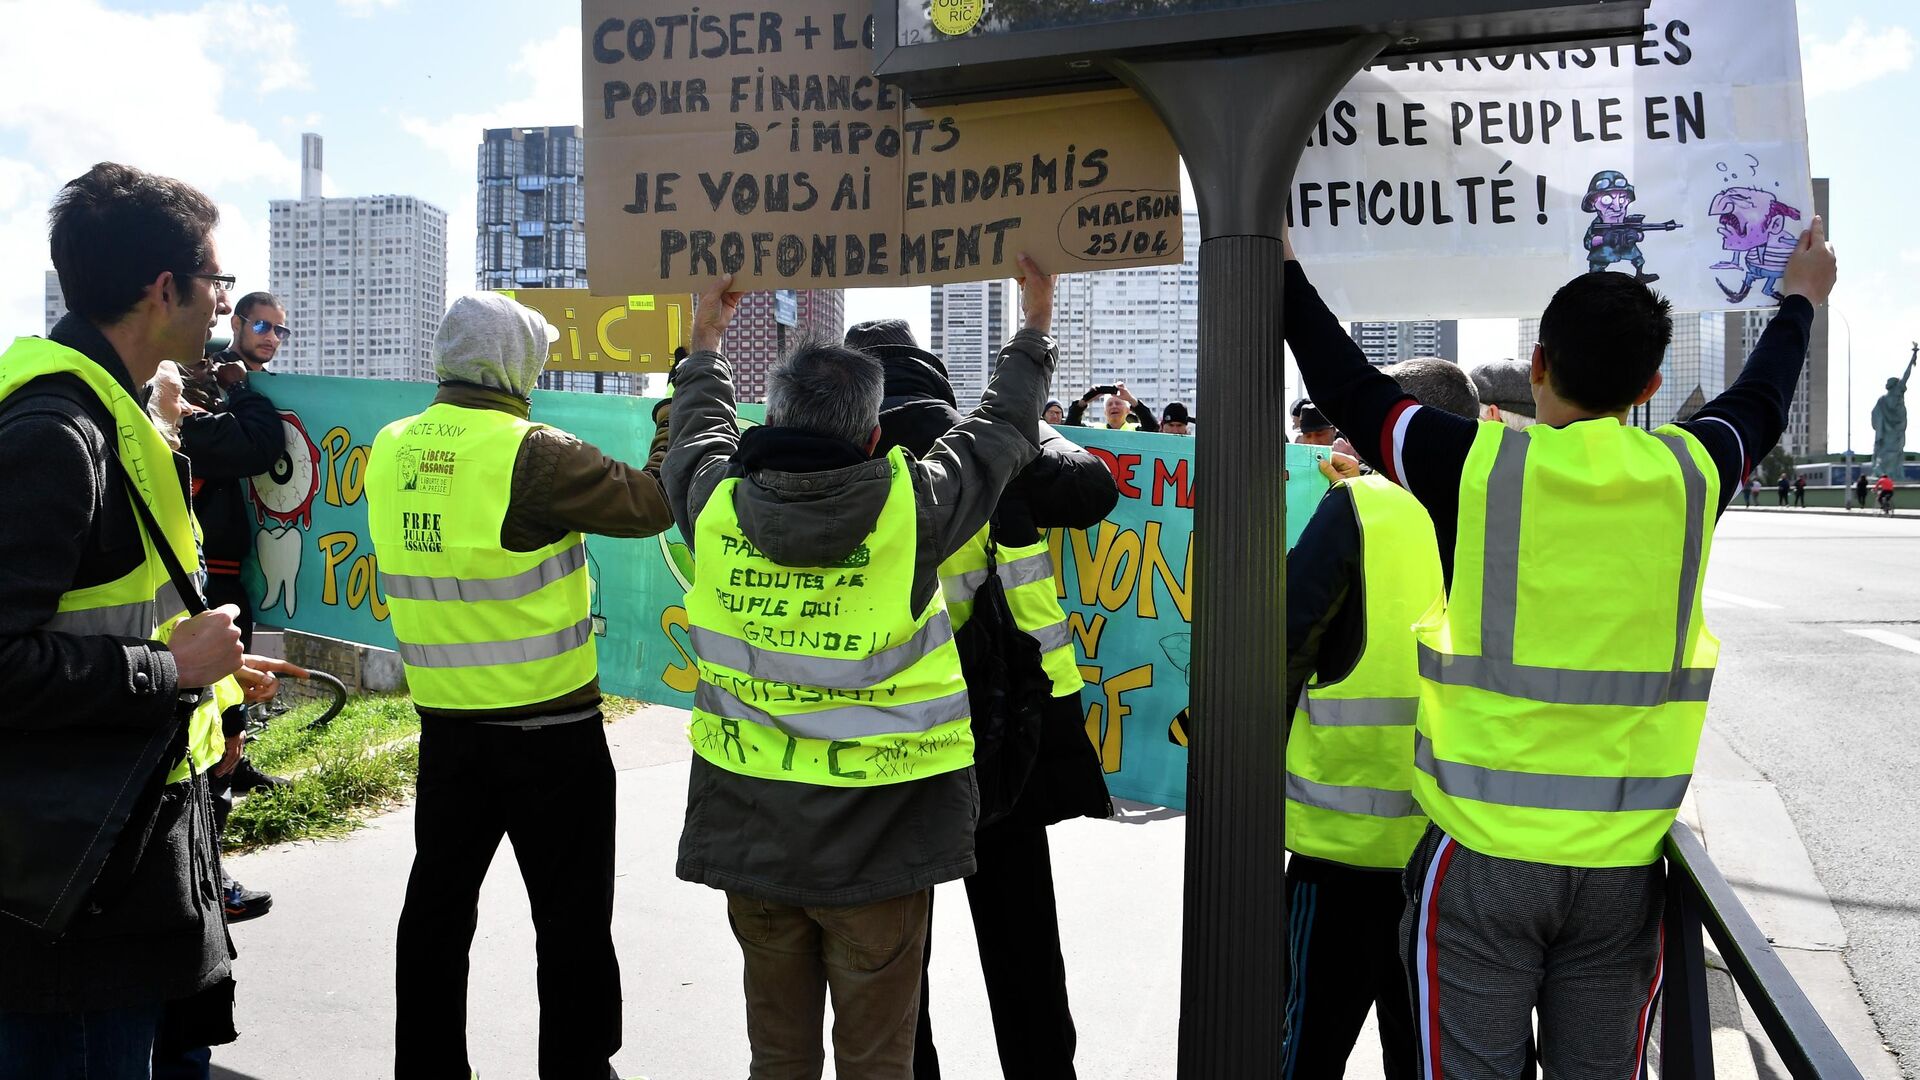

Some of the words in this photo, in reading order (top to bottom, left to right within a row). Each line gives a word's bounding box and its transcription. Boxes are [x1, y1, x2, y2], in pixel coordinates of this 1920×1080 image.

[604, 78, 709, 119] POUR
[1377, 102, 1427, 146] LE
[1451, 97, 1622, 145] PEUPLE
[1645, 91, 1705, 144] EN
[623, 172, 681, 214] JE
[698, 171, 818, 215] VOUS
[1286, 160, 1515, 228] IFFICULTÉ
[1078, 195, 1179, 228] MACRON
[1083, 229, 1168, 256] 25/04
[407, 424, 433, 437] ACTE
[435, 424, 467, 437] XXIV
[419, 462, 455, 475] ASSANGE
[402, 512, 441, 531] FREE
[403, 529, 441, 542] JULIAN
[404, 541, 443, 552] ASSANGE
[730, 568, 824, 590] ECOUTES
[715, 588, 789, 617] PEUPLE
[743, 621, 861, 651] GRONDE
